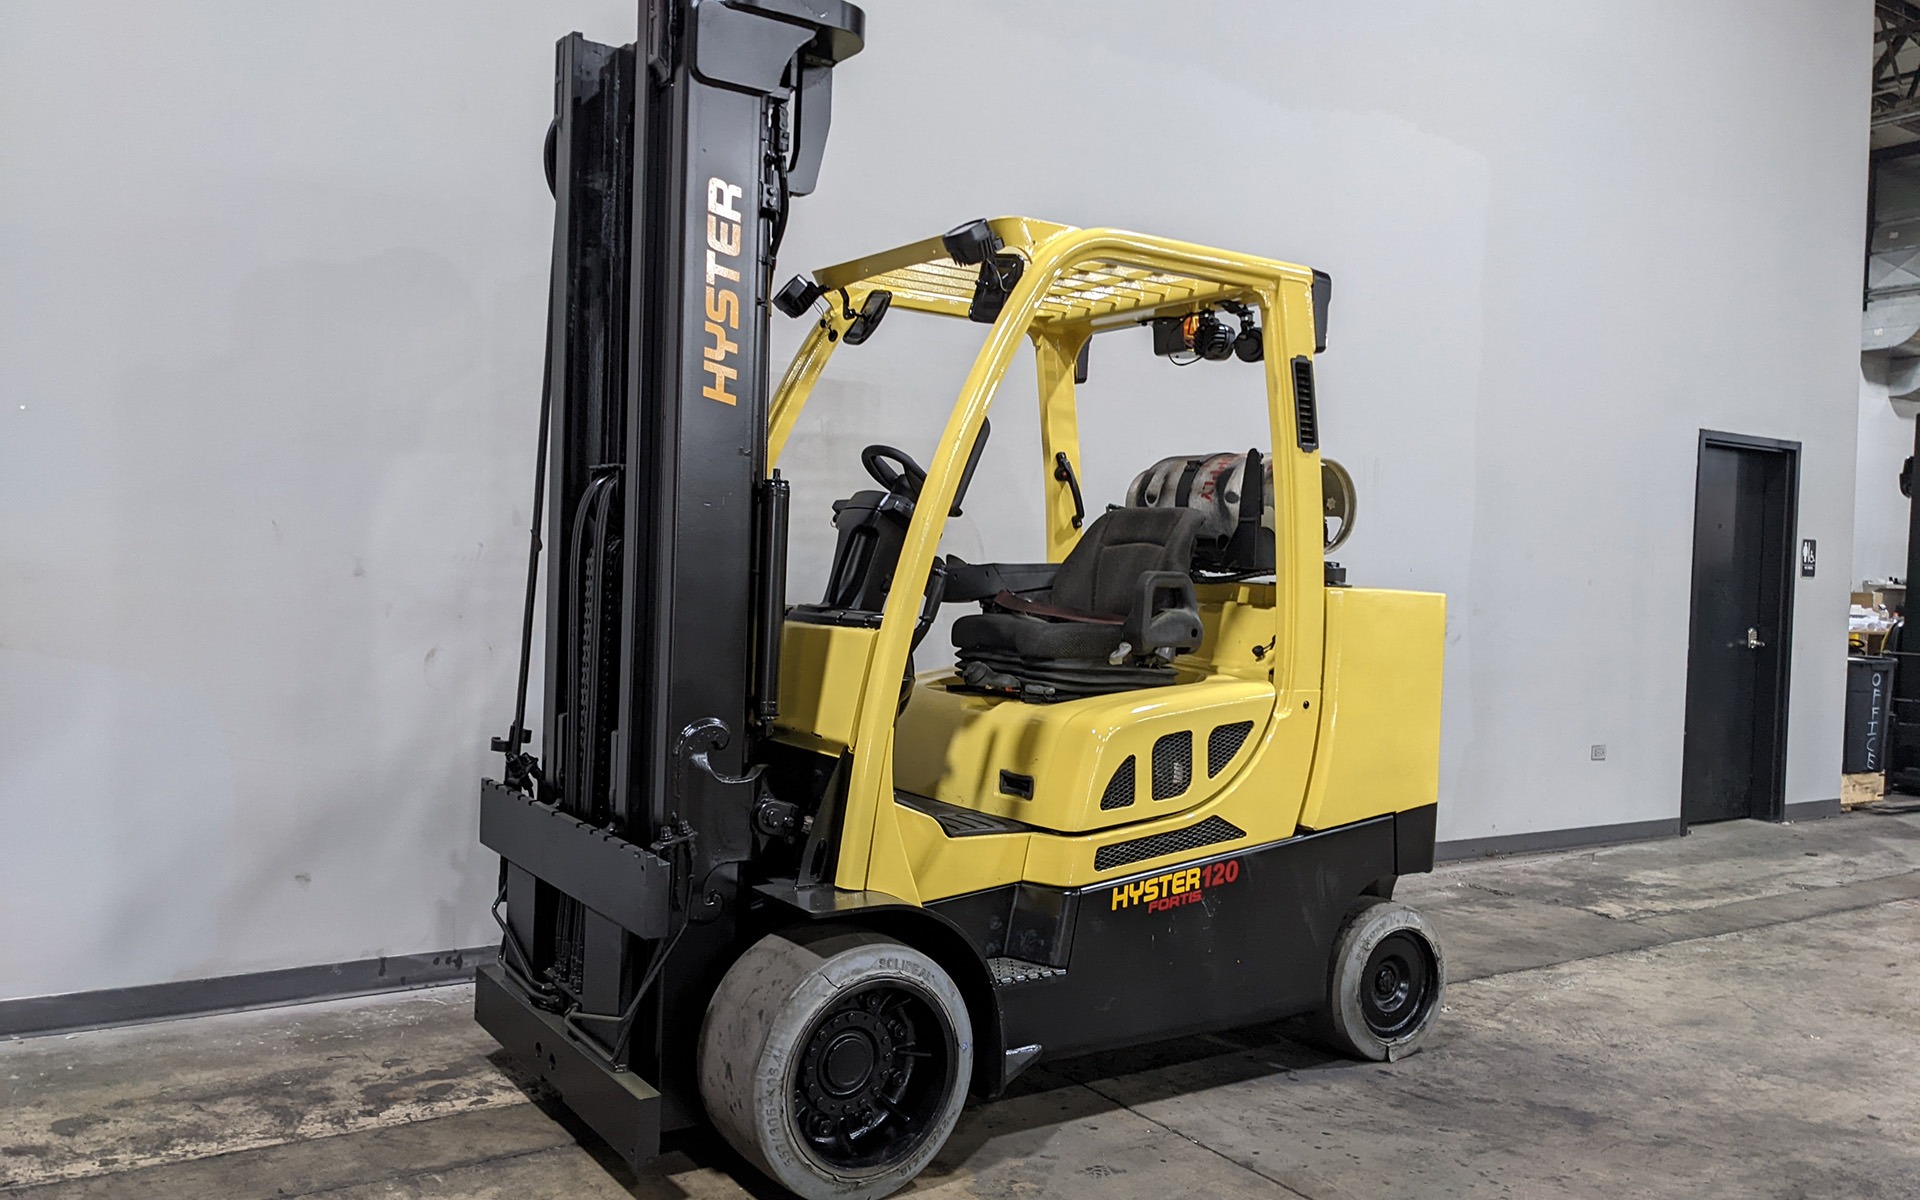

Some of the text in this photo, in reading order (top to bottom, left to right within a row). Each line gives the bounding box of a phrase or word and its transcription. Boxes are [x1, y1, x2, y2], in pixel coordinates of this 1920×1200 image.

[702, 176, 742, 407] HYSTER
[1866, 672, 1881, 770] OFFICE
[1111, 860, 1239, 911] HYSTER 120
[1147, 889, 1202, 914] FORTIS
